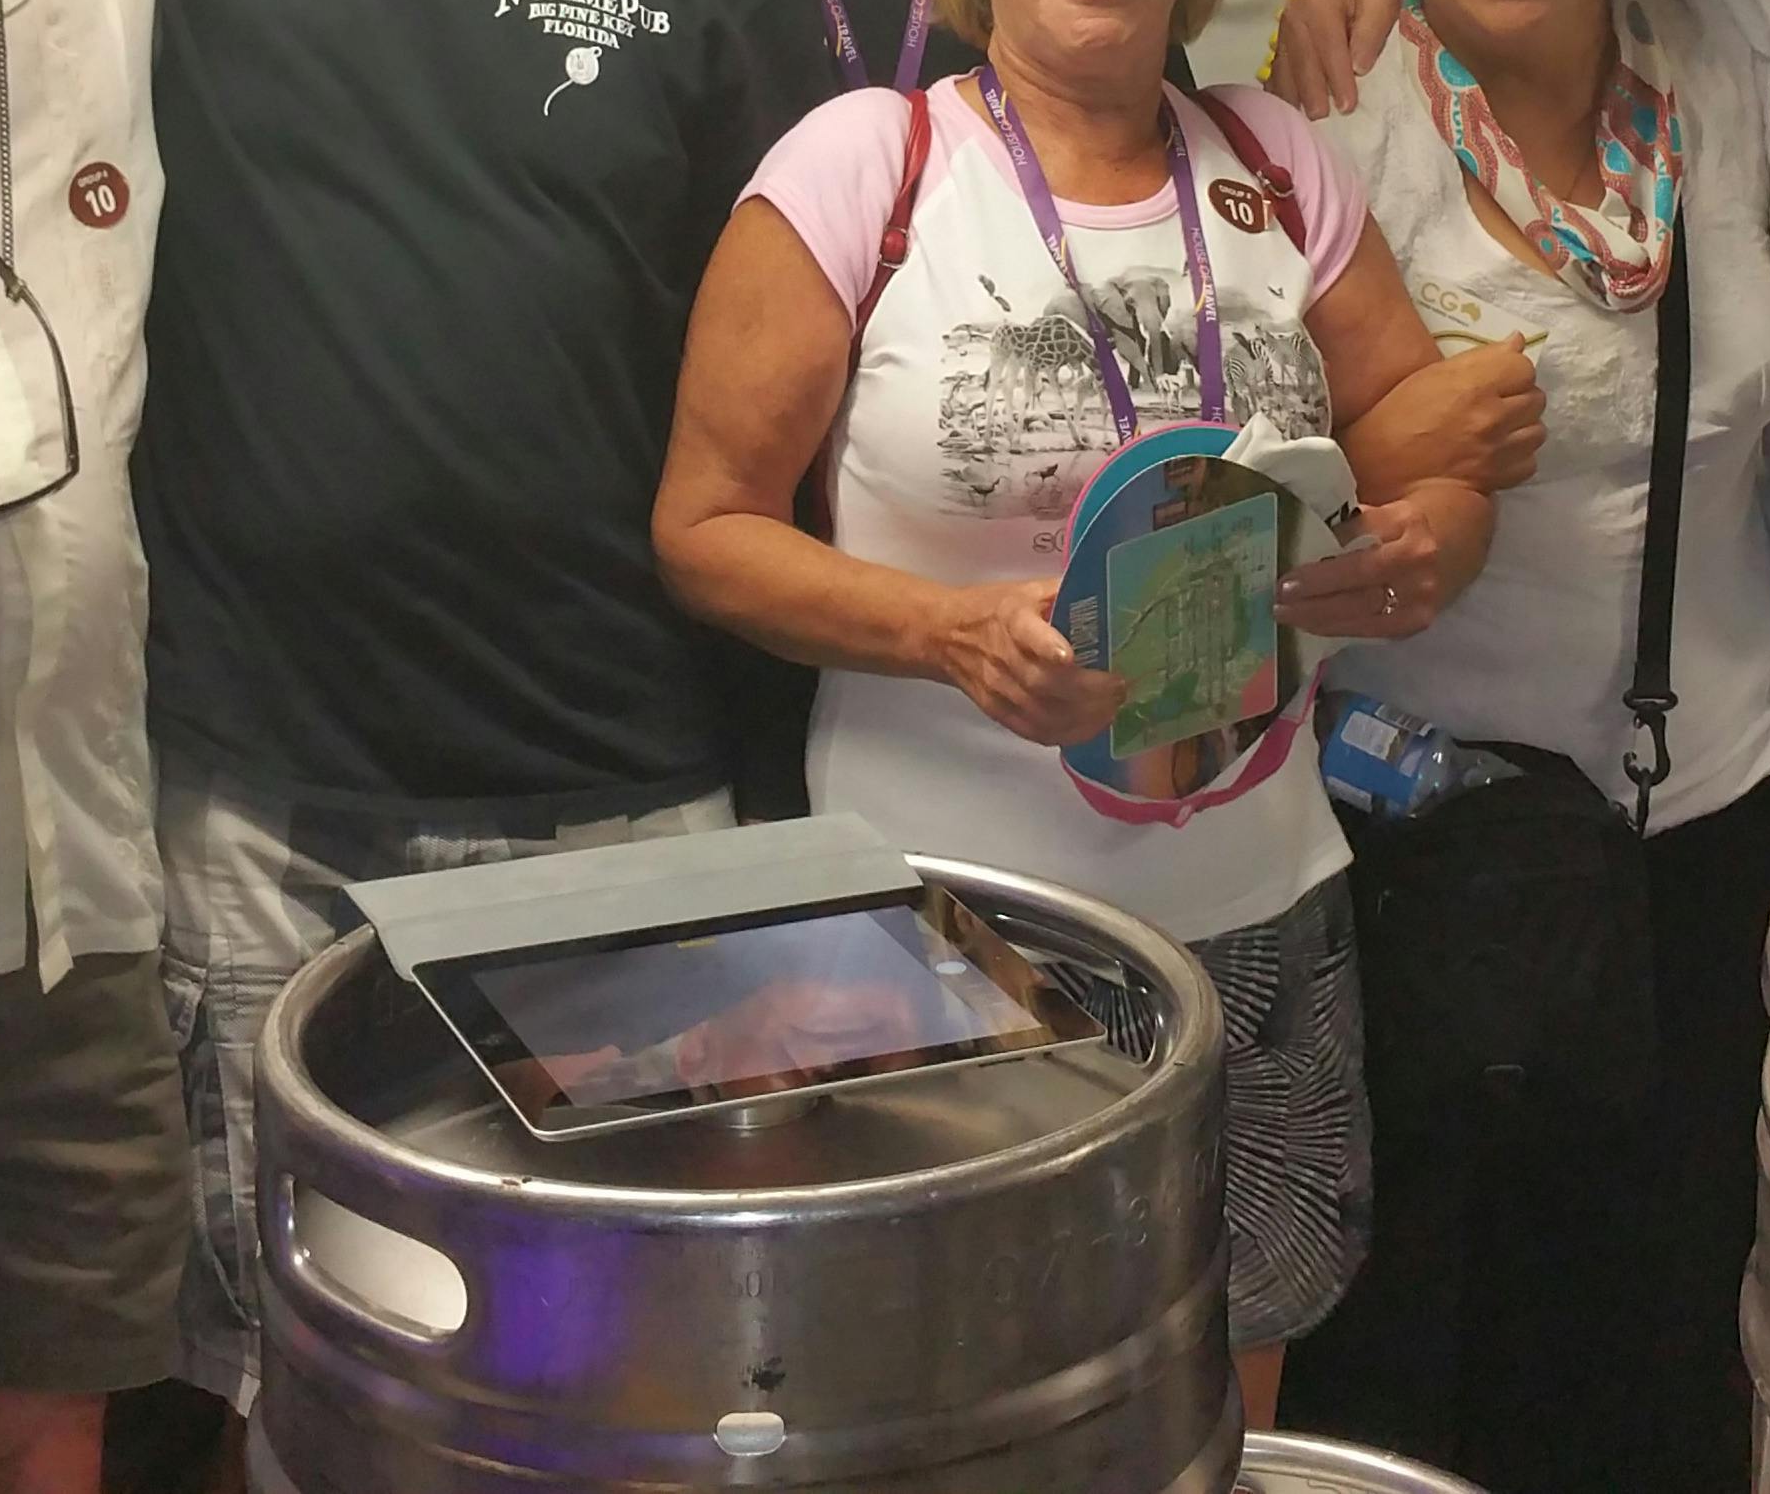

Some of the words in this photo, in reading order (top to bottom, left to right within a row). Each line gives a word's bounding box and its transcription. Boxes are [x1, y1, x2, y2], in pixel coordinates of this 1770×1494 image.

[528, 2, 558, 20] BIG
[558, 3, 601, 25] PINE
[601, 12, 637, 39] KEY
[543, 18, 621, 50] FLORIDA
[85, 185, 117, 217] 10
[1225, 198, 1255, 225] 10
